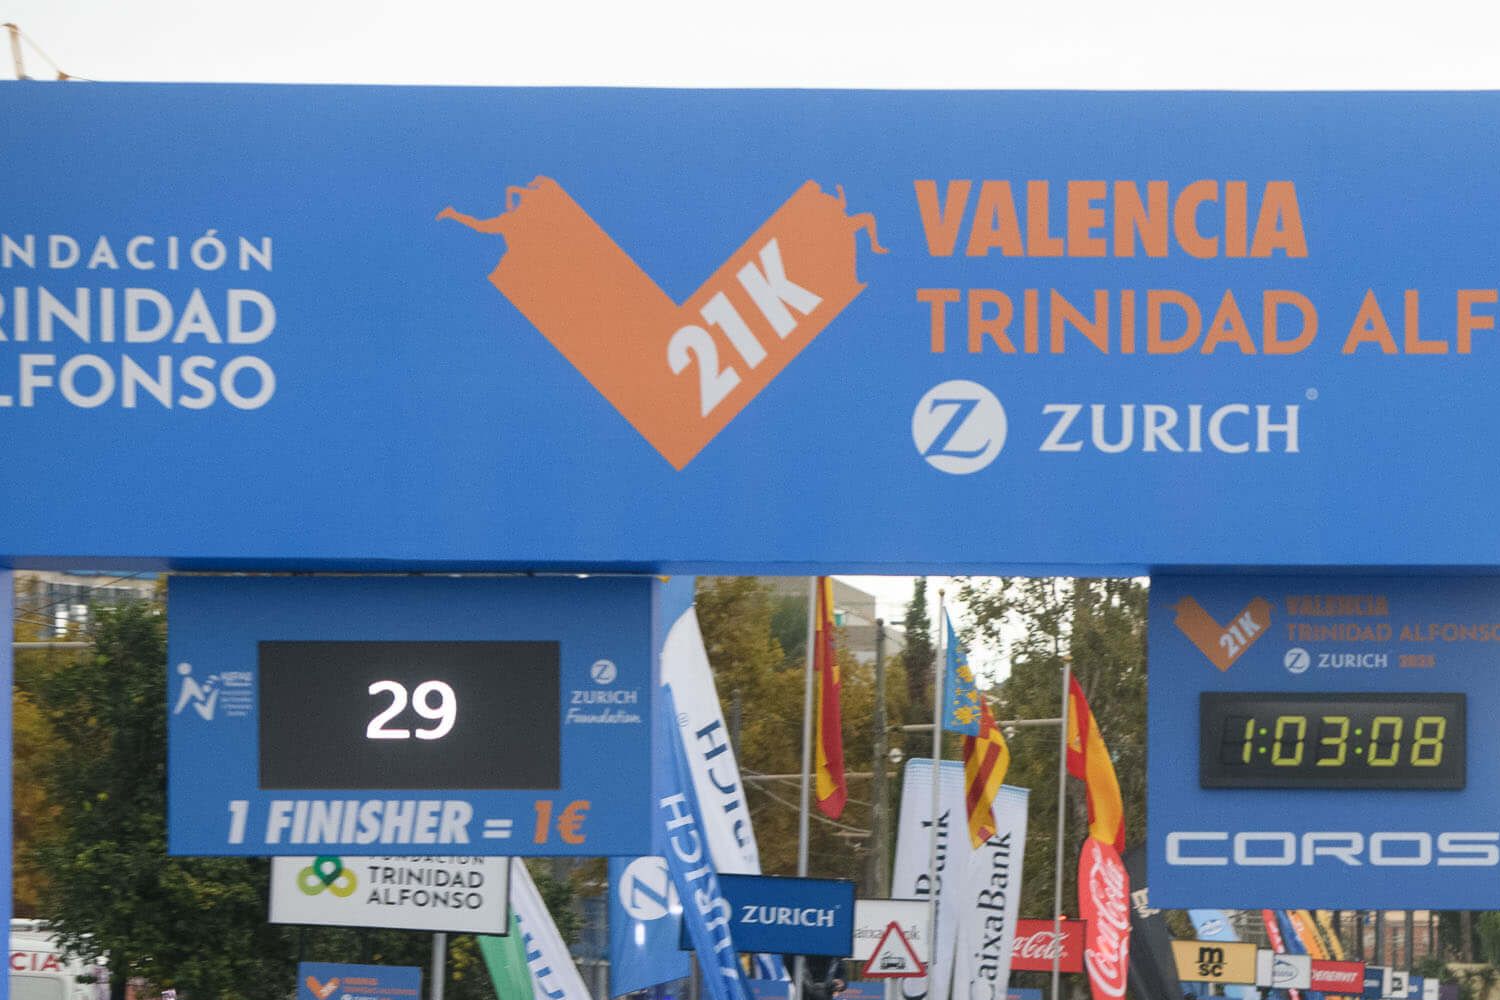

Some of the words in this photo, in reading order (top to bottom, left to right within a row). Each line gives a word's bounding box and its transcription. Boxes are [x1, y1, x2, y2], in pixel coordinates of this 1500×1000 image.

[914, 180, 1308, 258] VALENCIA
[1, 229, 273, 271] NDACIÓN
[0, 286, 276, 344] INIDAD
[667, 238, 823, 418] 21K
[916, 288, 1319, 354] TRINIDAD
[1039, 404, 1301, 453] ZURICH
[1219, 611, 1262, 659] 21K
[1287, 623, 1393, 641] TRINIDAD
[1318, 653, 1388, 668] ZURICH
[365, 679, 458, 740] 29
[570, 690, 638, 704] ZURICH
[1242, 715, 1448, 767] 1:03:08
[227, 800, 246, 845] 1
[265, 800, 473, 845] FINISHER
[533, 800, 592, 845] 1€
[1165, 832, 1500, 866] COROS
[366, 888, 483, 909] ALFONSO
[367, 866, 484, 888] TRINIDAD
[740, 905, 835, 928] ZURICH
[10, 952, 61, 972] CIA
